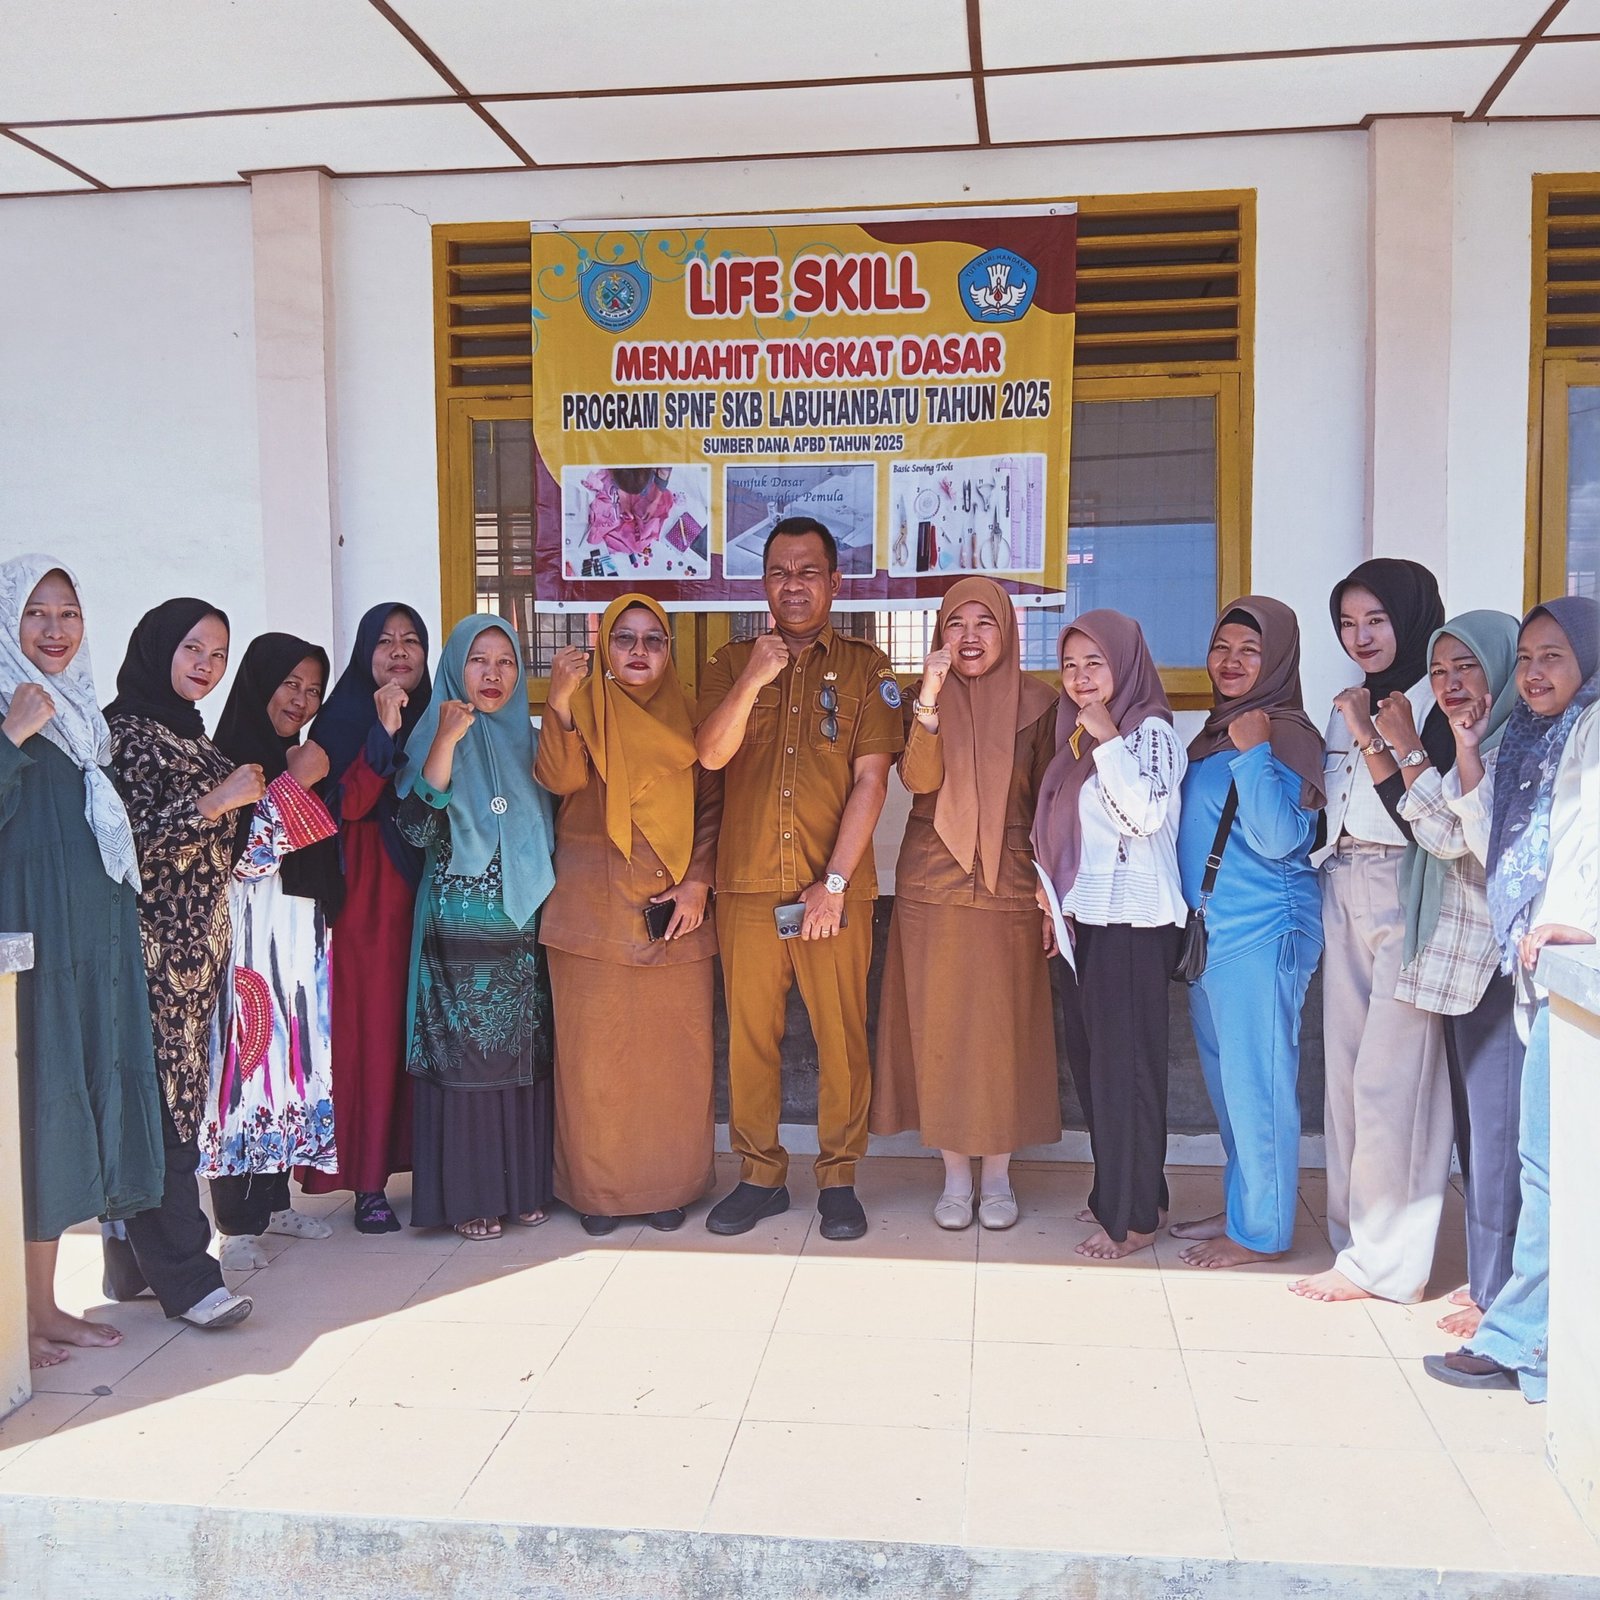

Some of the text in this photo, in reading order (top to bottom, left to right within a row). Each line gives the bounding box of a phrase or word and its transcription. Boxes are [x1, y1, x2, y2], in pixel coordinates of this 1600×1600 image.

[689, 255, 926, 316] LIFE SKILL
[615, 336, 1002, 382] MENJAHIT TINGKAT DASAR
[562, 380, 1051, 430] PROGRAM SPNF SKB LABUHANBATU TAHUN 2025
[703, 434, 904, 454] SUMBER DANA APBD TAHUN 2025
[893, 461, 954, 476] Basic Sewing Tools
[770, 476, 805, 488] Dasar
[802, 488, 844, 502] Pemula
